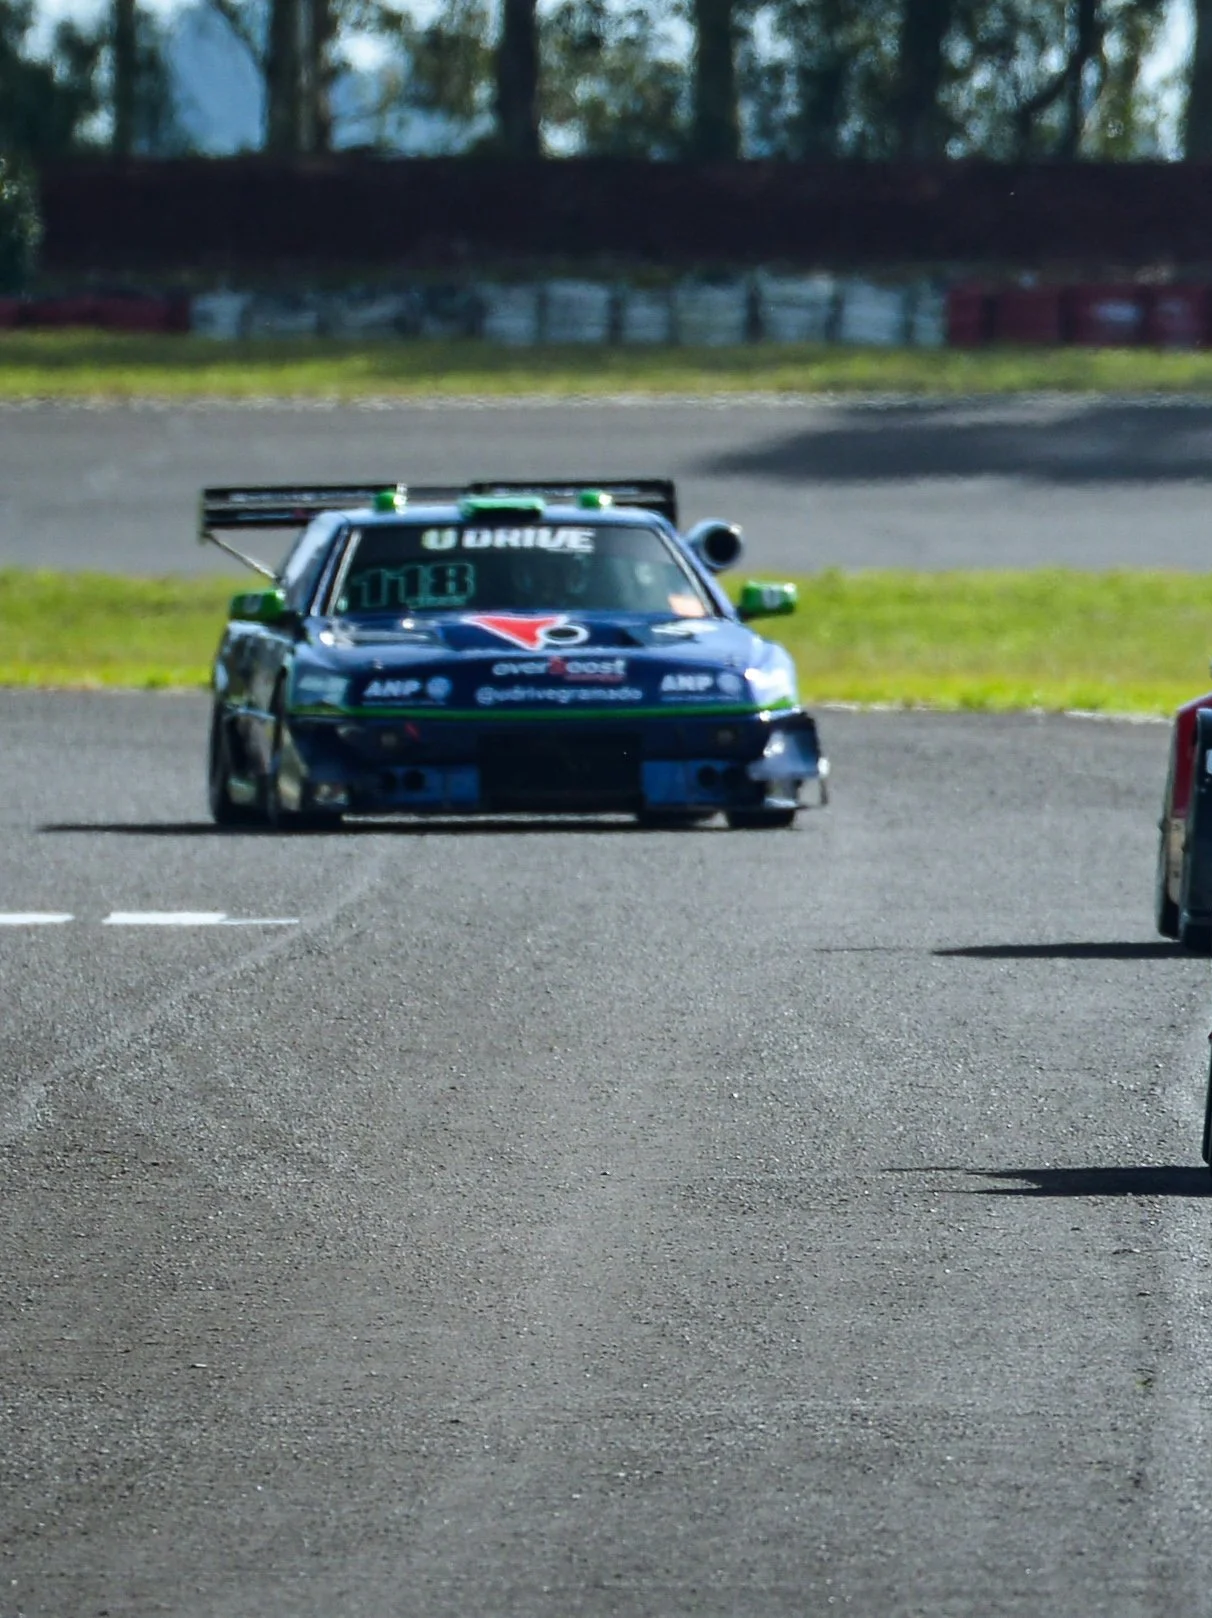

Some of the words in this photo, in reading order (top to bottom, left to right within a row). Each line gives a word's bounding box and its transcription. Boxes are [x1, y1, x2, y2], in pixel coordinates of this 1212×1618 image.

[421, 528, 458, 549] U
[461, 527, 597, 552] DRIVE
[352, 561, 476, 608] 118
[363, 680, 422, 698] ANP
[659, 674, 715, 692] ANP
